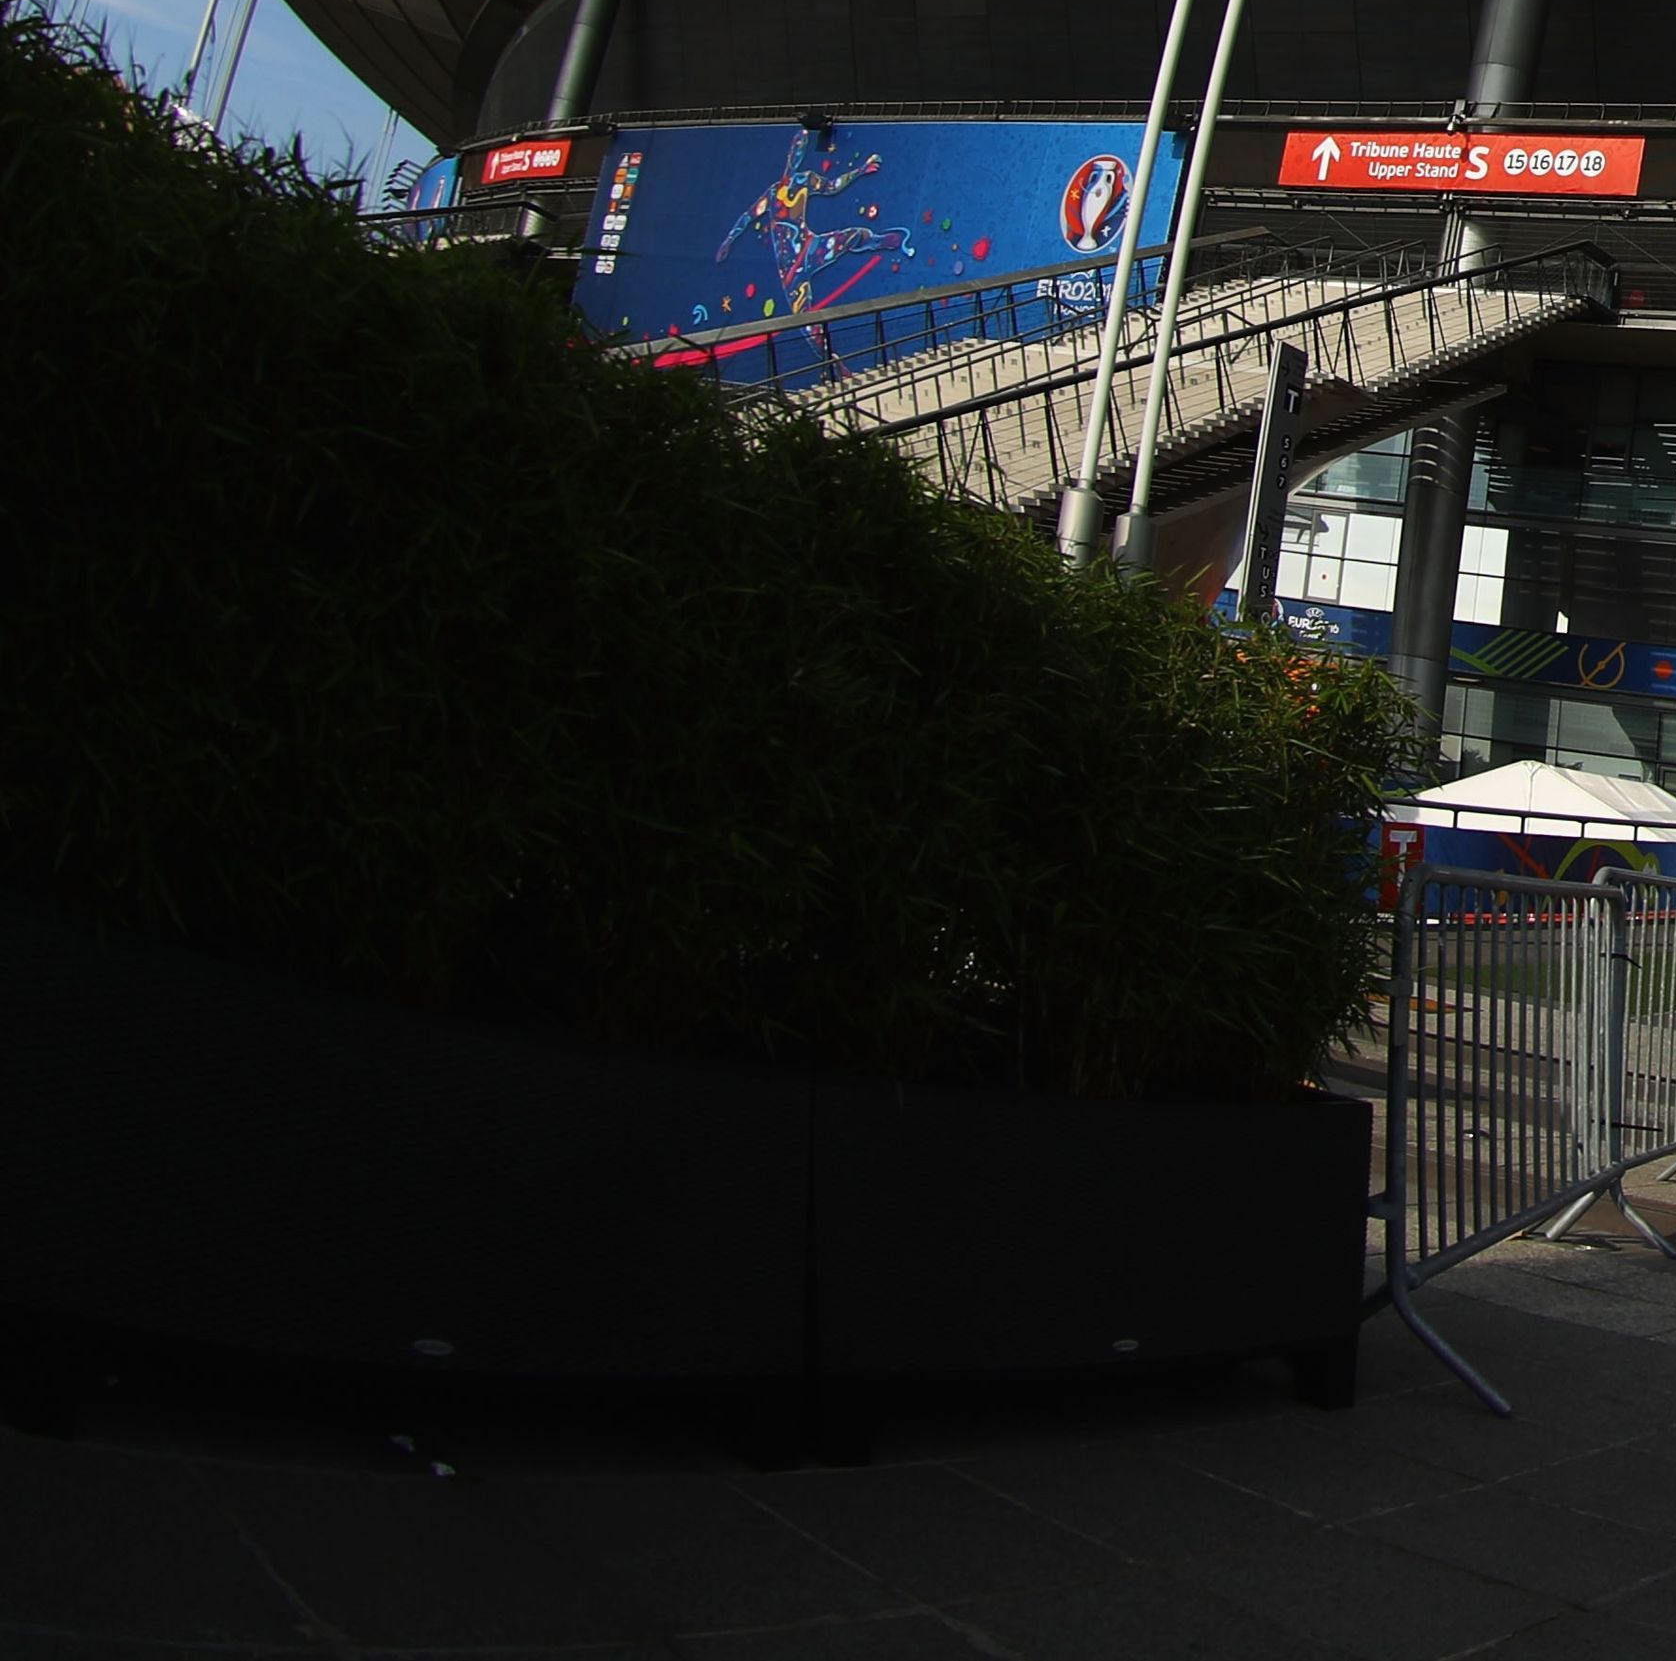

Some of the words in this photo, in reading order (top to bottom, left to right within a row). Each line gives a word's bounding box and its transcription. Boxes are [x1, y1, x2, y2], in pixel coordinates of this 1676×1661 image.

[1350, 142, 1409, 158] Tribune
[1412, 143, 1461, 159] Haute
[1465, 146, 1490, 180] S
[1507, 153, 1525, 169] 15
[1532, 154, 1550, 170] 16
[1556, 155, 1575, 170] 17
[1583, 155, 1602, 171] 18
[1368, 162, 1412, 180] Upper
[1416, 162, 1458, 178] Stand
[1287, 388, 1299, 413] T
[1280, 457, 1287, 468] 6
[1278, 476, 1285, 487] 7
[1260, 547, 1267, 559] T
[1263, 567, 1270, 579] U
[1260, 586, 1267, 598] S
